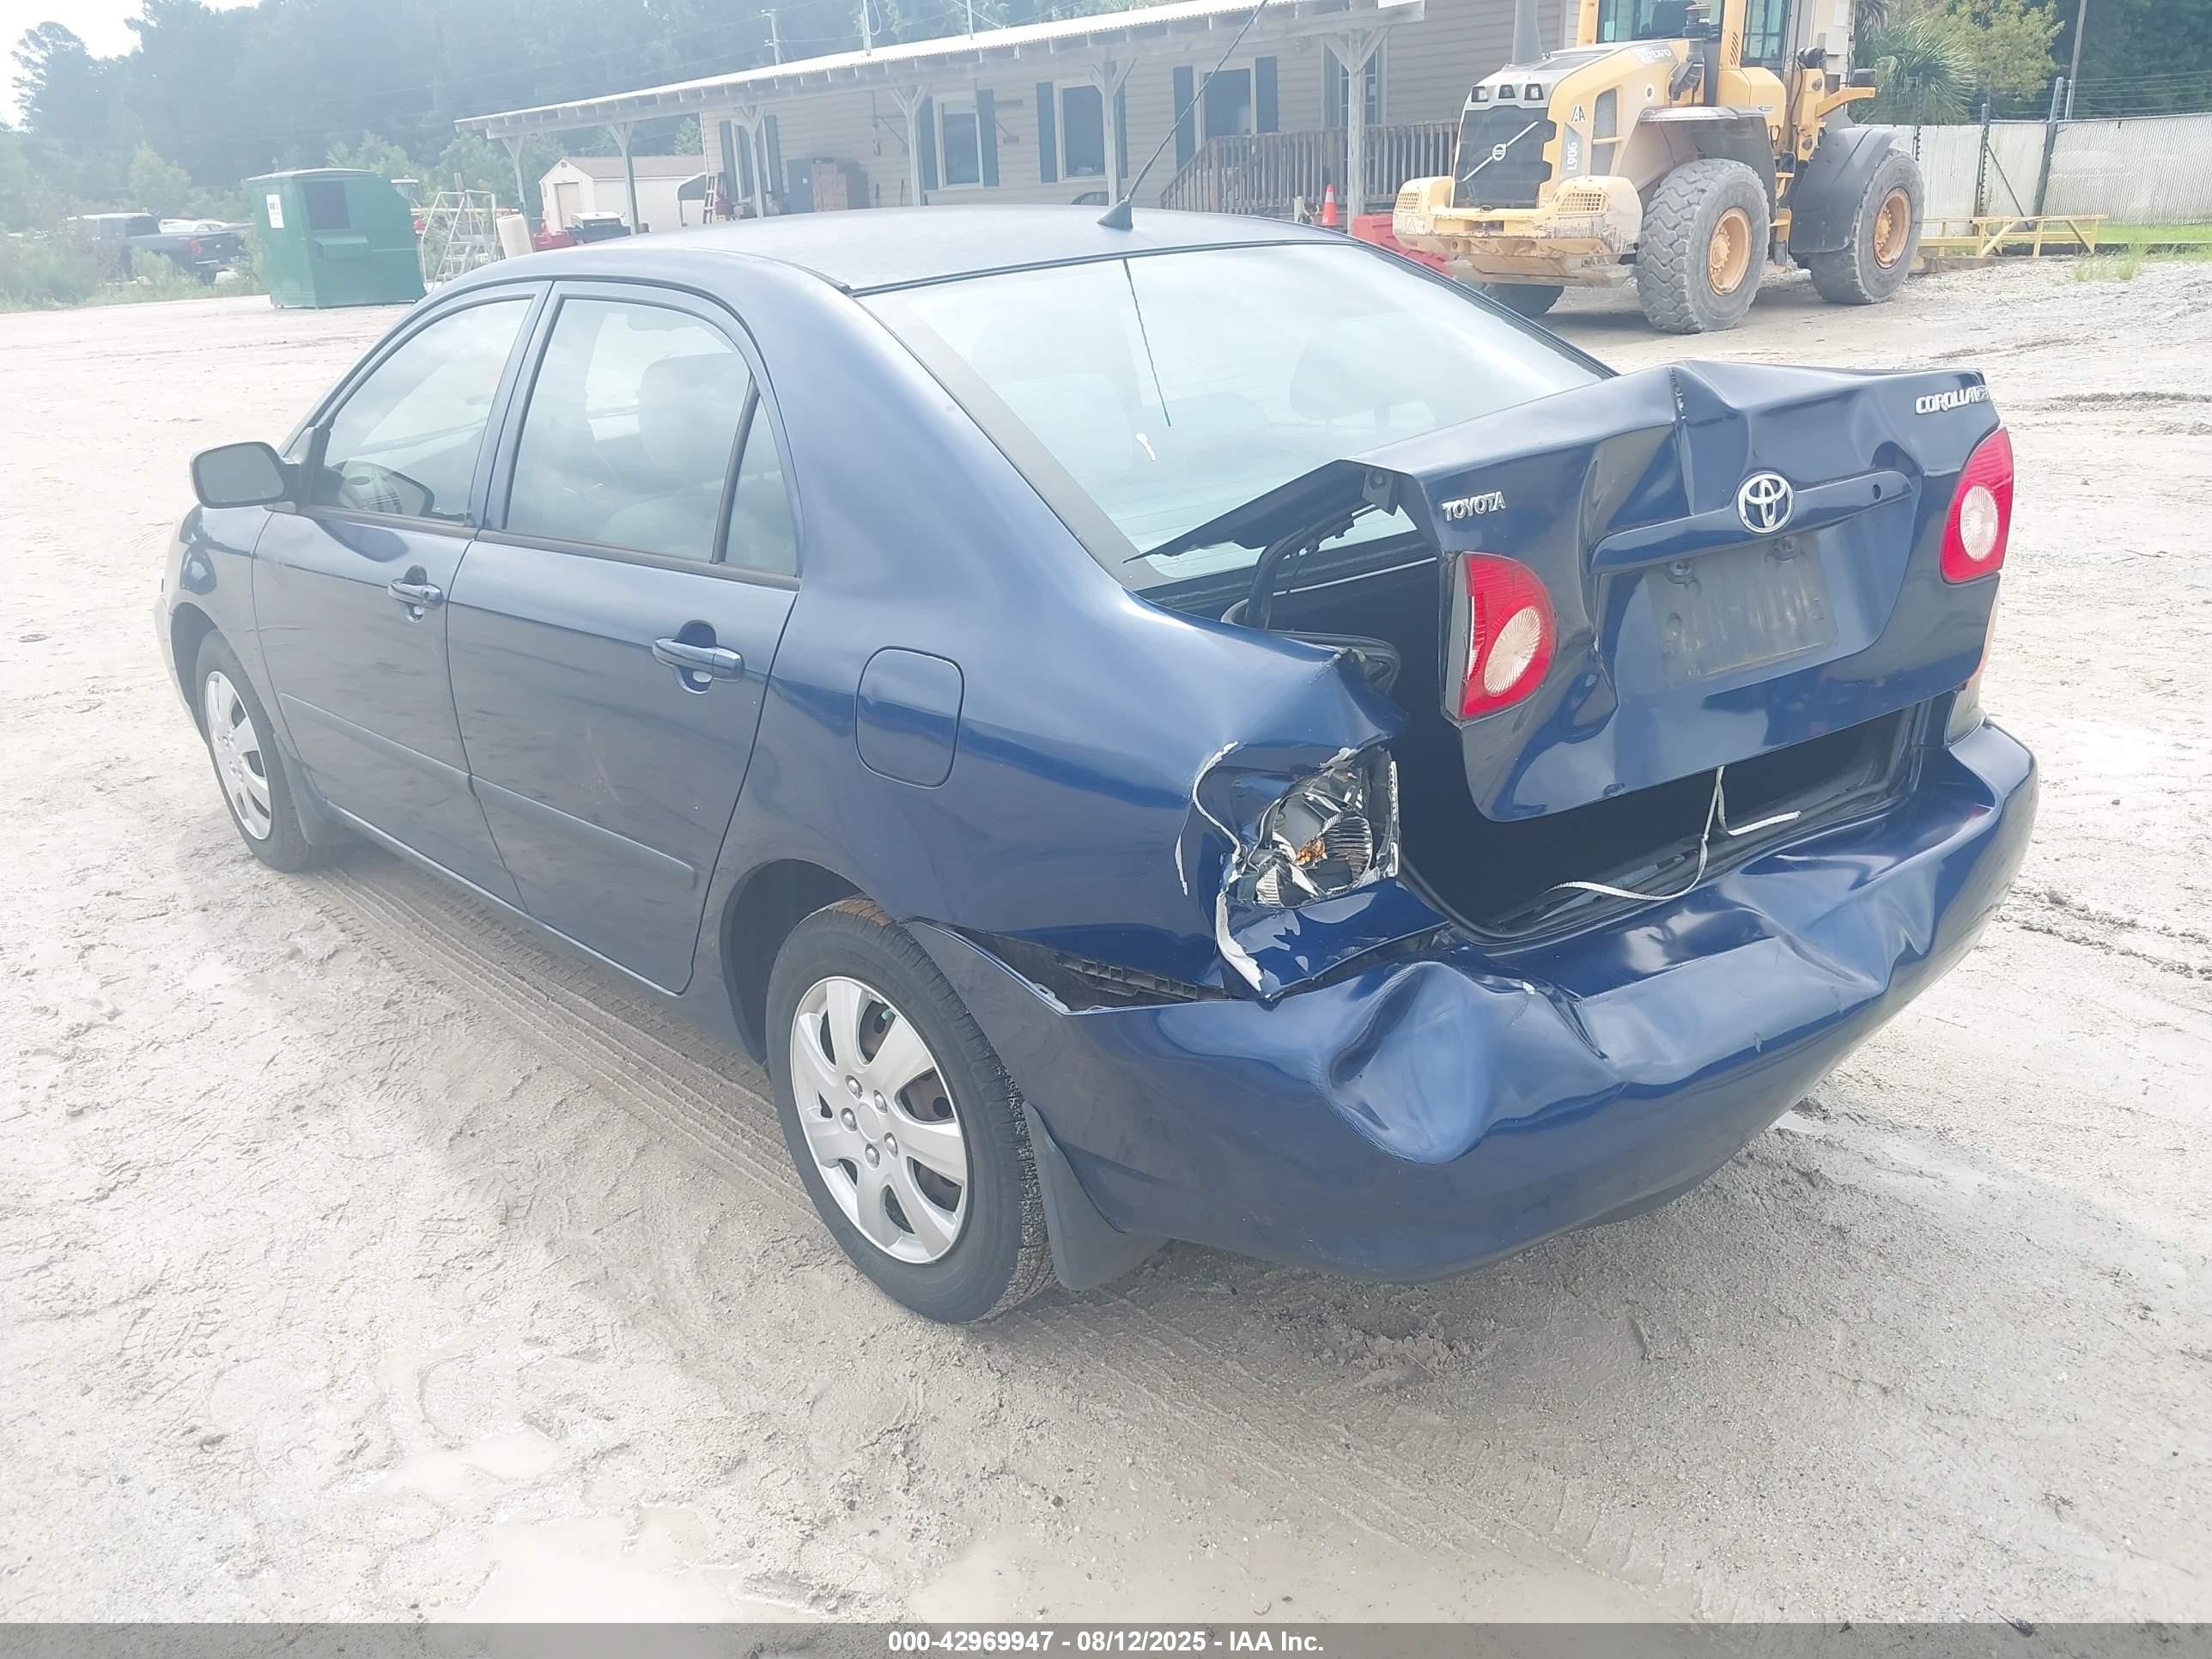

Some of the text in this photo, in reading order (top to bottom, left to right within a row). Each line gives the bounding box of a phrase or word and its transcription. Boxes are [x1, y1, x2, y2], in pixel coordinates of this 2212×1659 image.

[1566, 141, 1578, 171] L90G
[1915, 386, 1975, 414] COROLLA
[1442, 490, 1506, 522] TOYOTA
